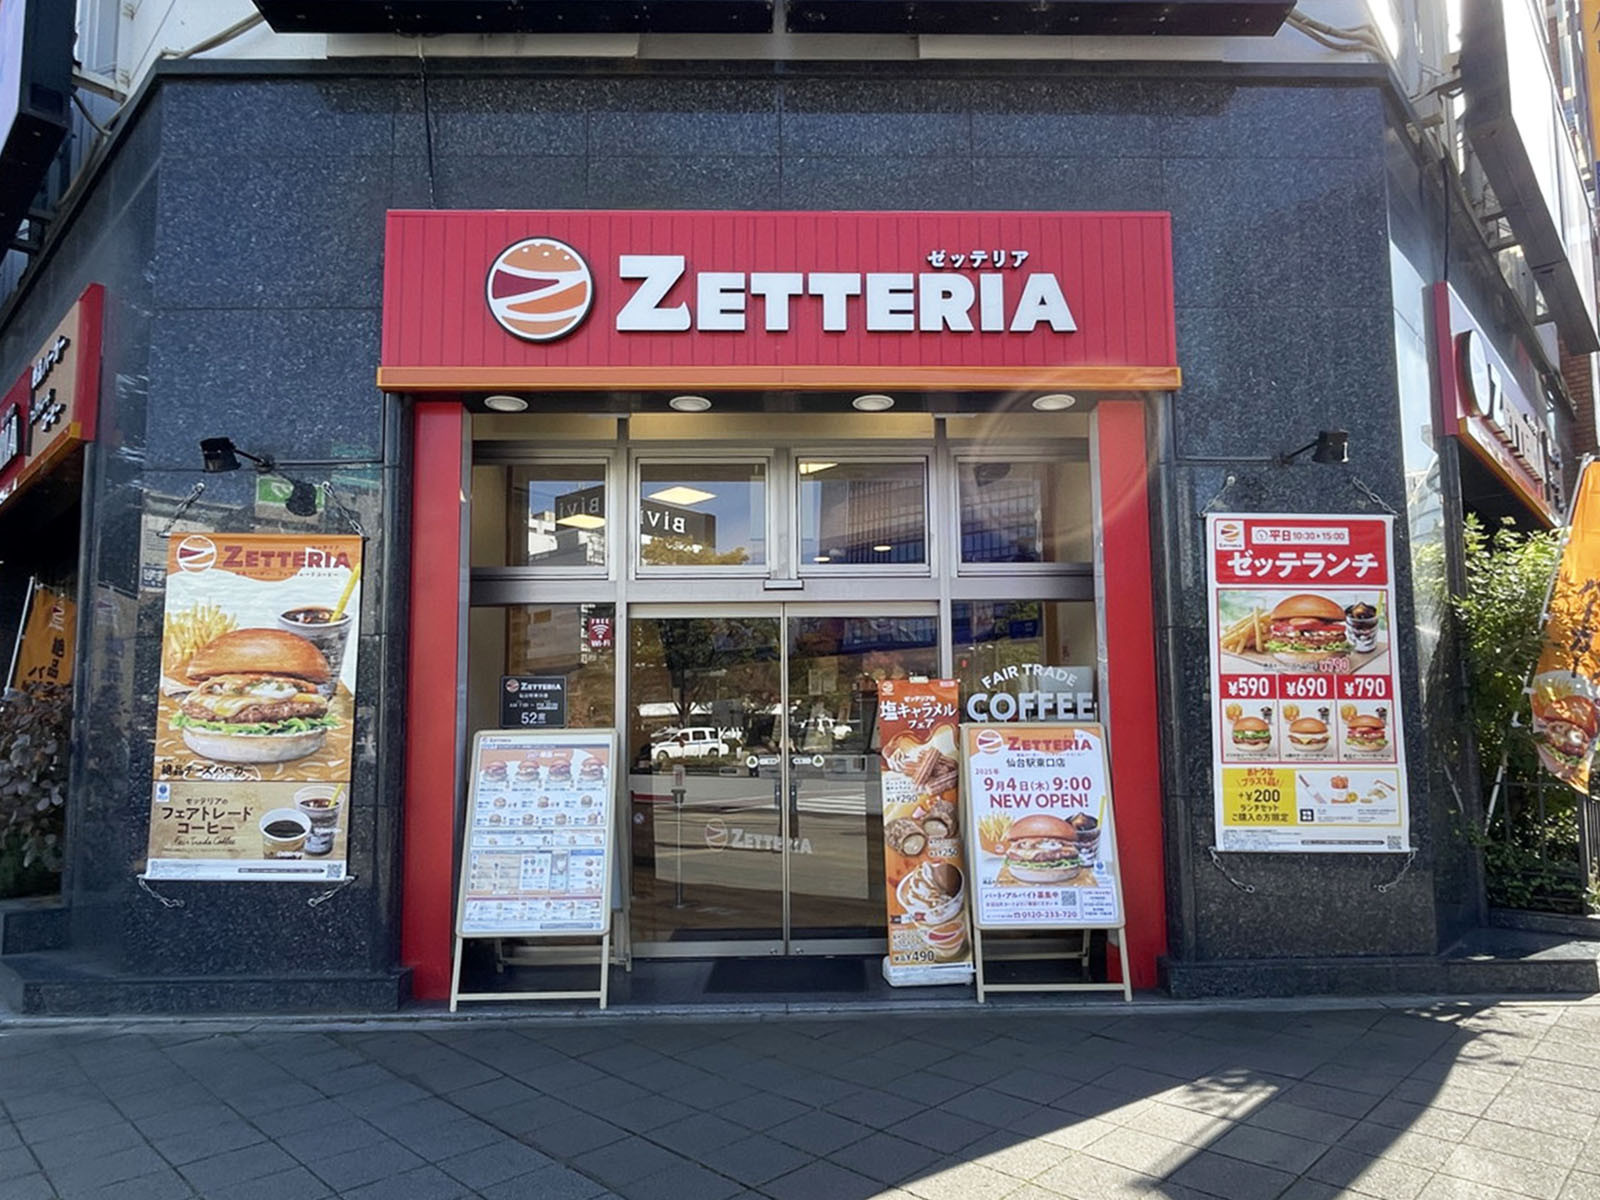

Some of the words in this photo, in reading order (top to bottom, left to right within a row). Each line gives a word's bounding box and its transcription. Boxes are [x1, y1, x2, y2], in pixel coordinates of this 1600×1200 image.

[927, 249, 1030, 268] ゼッテリア
[616, 255, 1078, 333] ZETTERIA
[1269, 529, 1291, 541] 平日
[1322, 532, 1346, 540] 15:00
[222, 545, 351, 569] ZETTERIA
[1227, 549, 1379, 578] ゼッテランチ
[981, 665, 1019, 689] FAIR
[1021, 663, 1077, 688] TRADE
[1228, 677, 1270, 696] ¥590
[1286, 677, 1327, 696] ¥690
[1344, 677, 1386, 697] ¥790
[880, 700, 957, 720] 塩キャラメル
[967, 692, 1094, 721] COFFEE
[1007, 737, 1093, 751] ZETTERIA
[1053, 776, 1092, 791] 9:00
[990, 794, 1032, 808] NEW
[1035, 793, 1089, 808] OPEN!
[161, 806, 254, 822] フェアトレード
[177, 822, 236, 835] コーヒー
[731, 828, 812, 854] ZETTEIA
